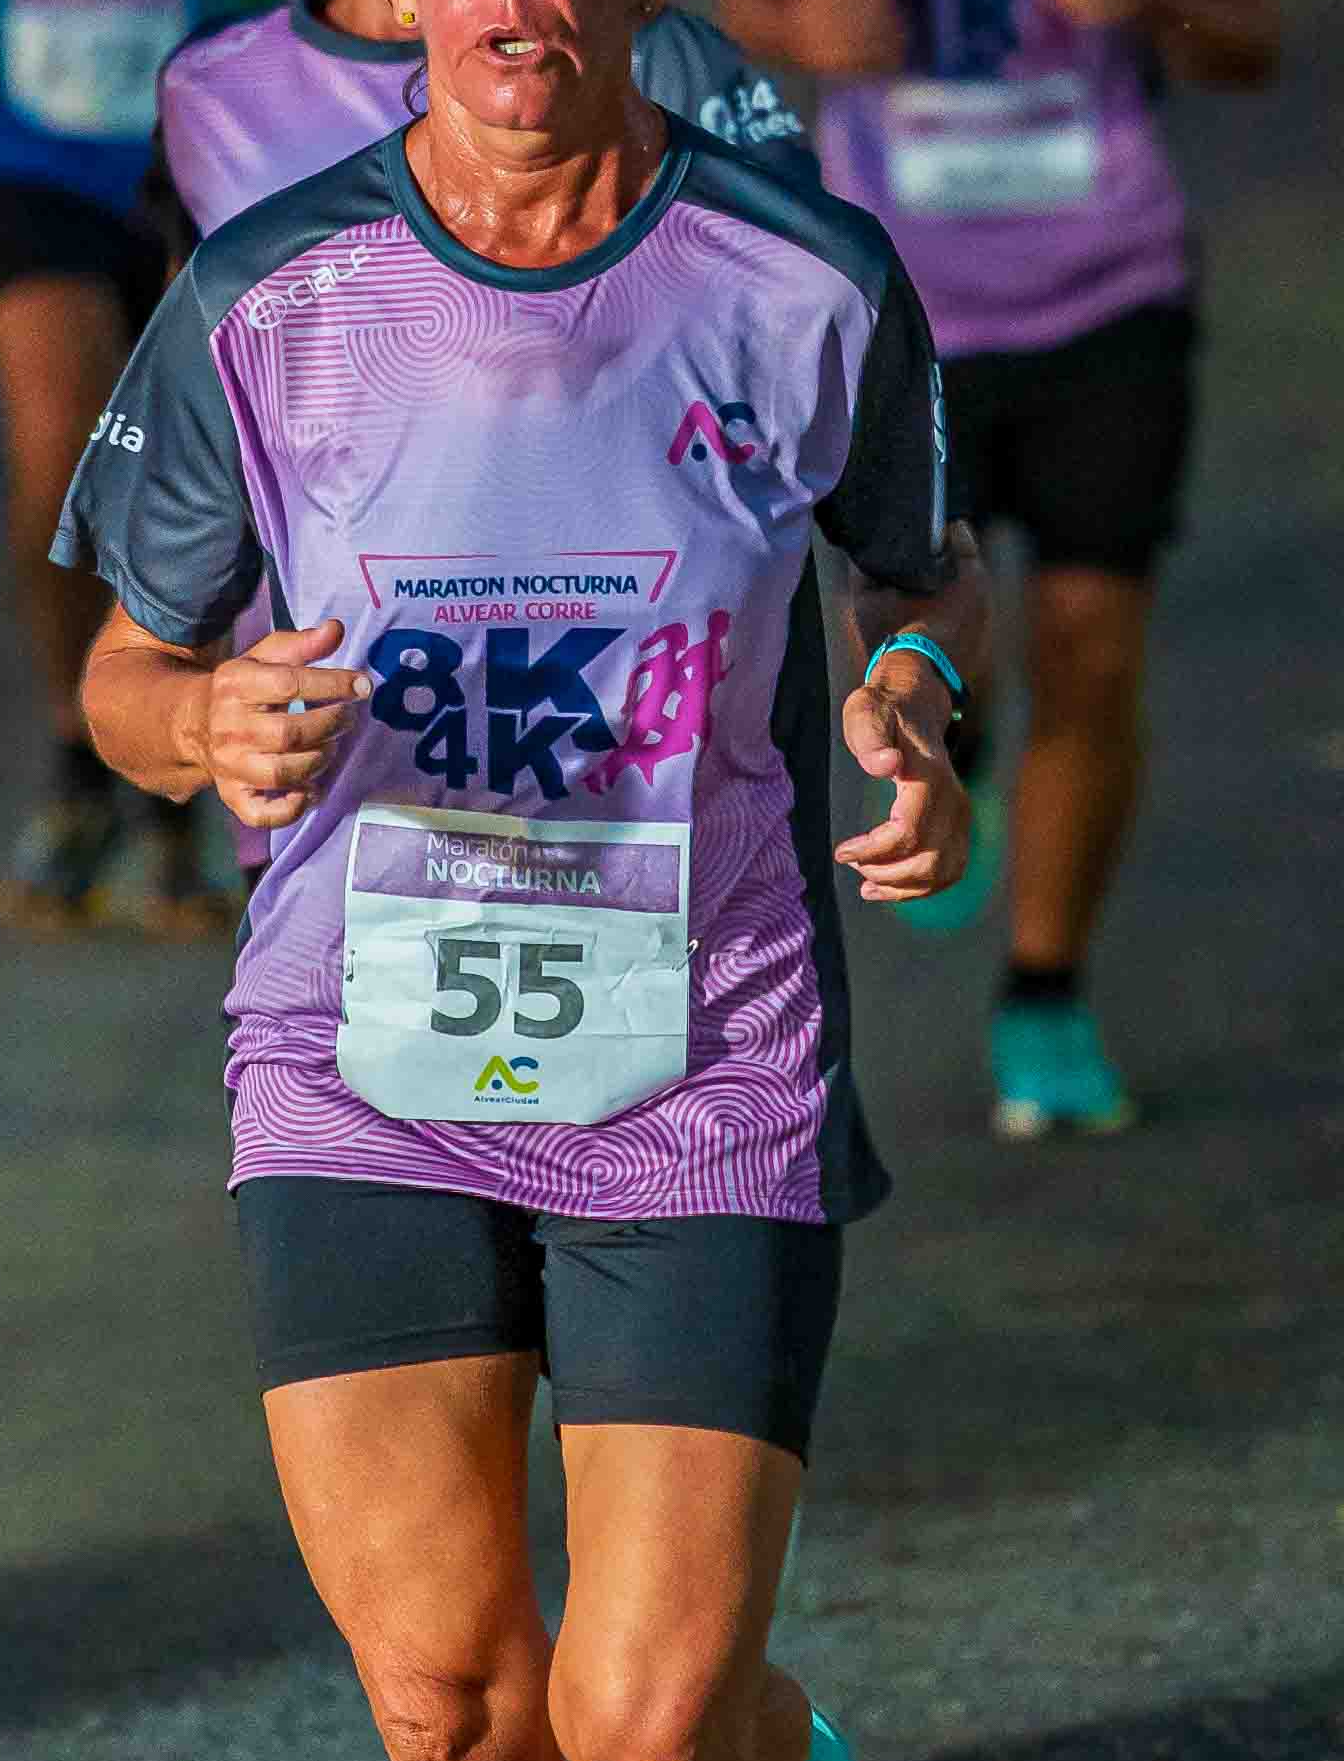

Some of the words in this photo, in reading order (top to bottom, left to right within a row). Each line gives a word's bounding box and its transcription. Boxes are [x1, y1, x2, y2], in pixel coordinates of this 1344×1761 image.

[394, 576, 504, 598] MARATON
[512, 575, 640, 595] NOCTURNA
[433, 602, 517, 624] ALVEAR
[525, 601, 598, 620] CORRE
[367, 627, 631, 752] 8K
[414, 707, 570, 801] 4K
[426, 834, 530, 862] Maratón
[425, 858, 602, 895] NOCTURNA
[430, 938, 585, 1040] 55
